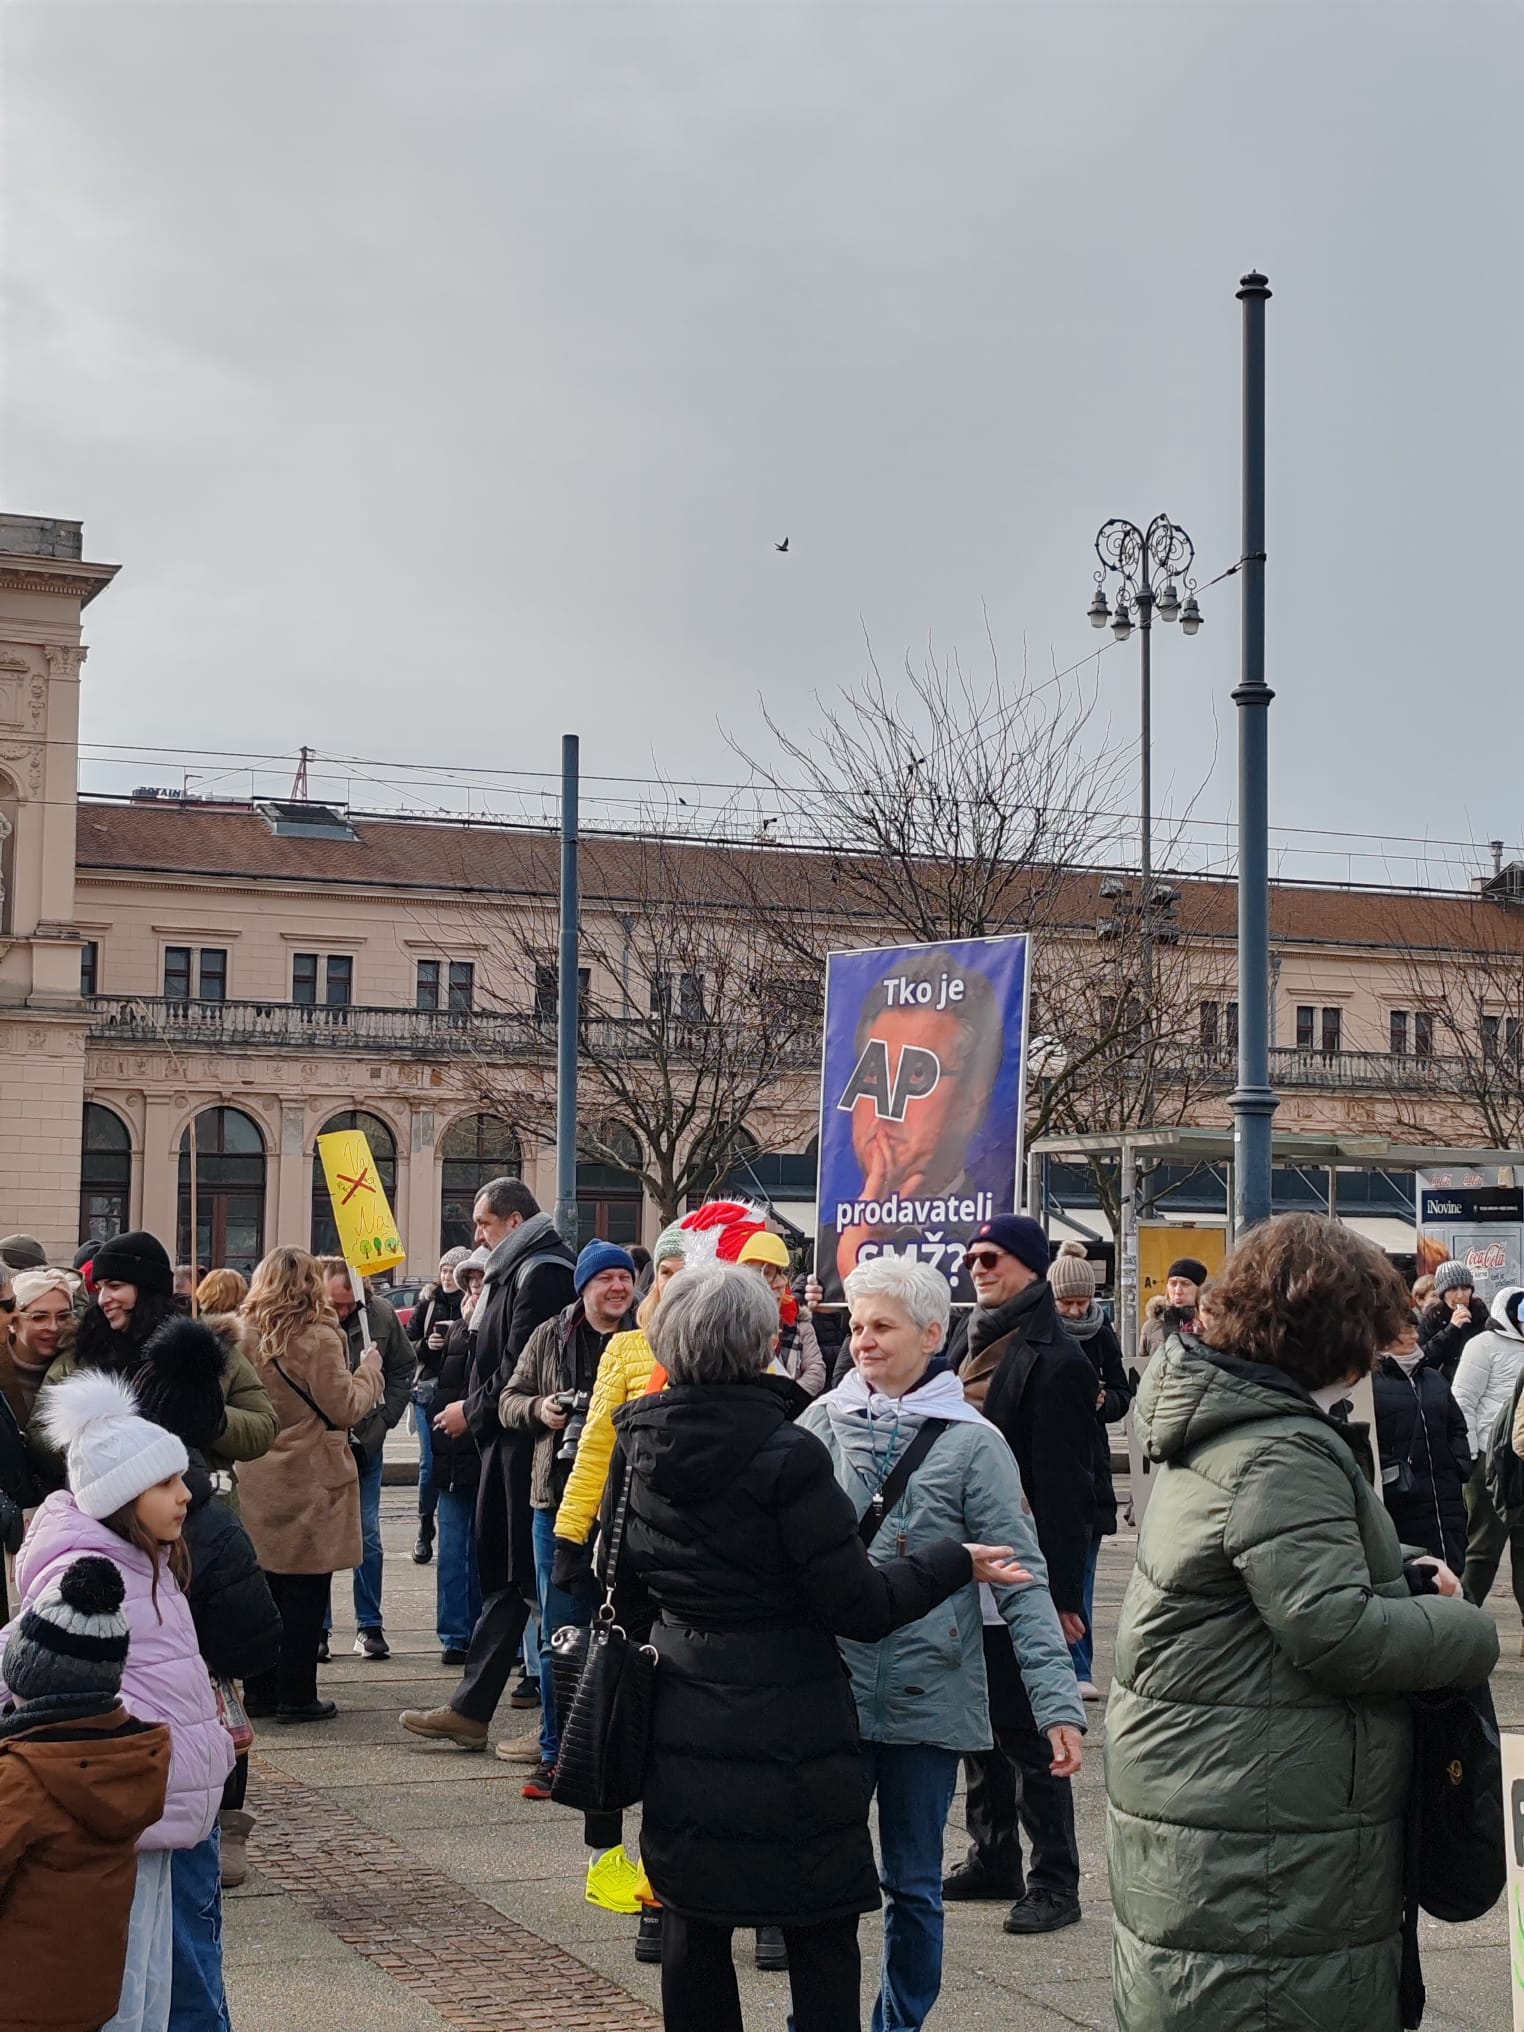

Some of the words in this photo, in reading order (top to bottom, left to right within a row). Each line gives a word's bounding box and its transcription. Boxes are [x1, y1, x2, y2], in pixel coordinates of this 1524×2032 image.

[883, 976, 932, 1006] Tko
[936, 973, 965, 1010] je
[836, 1037, 941, 1123] AP
